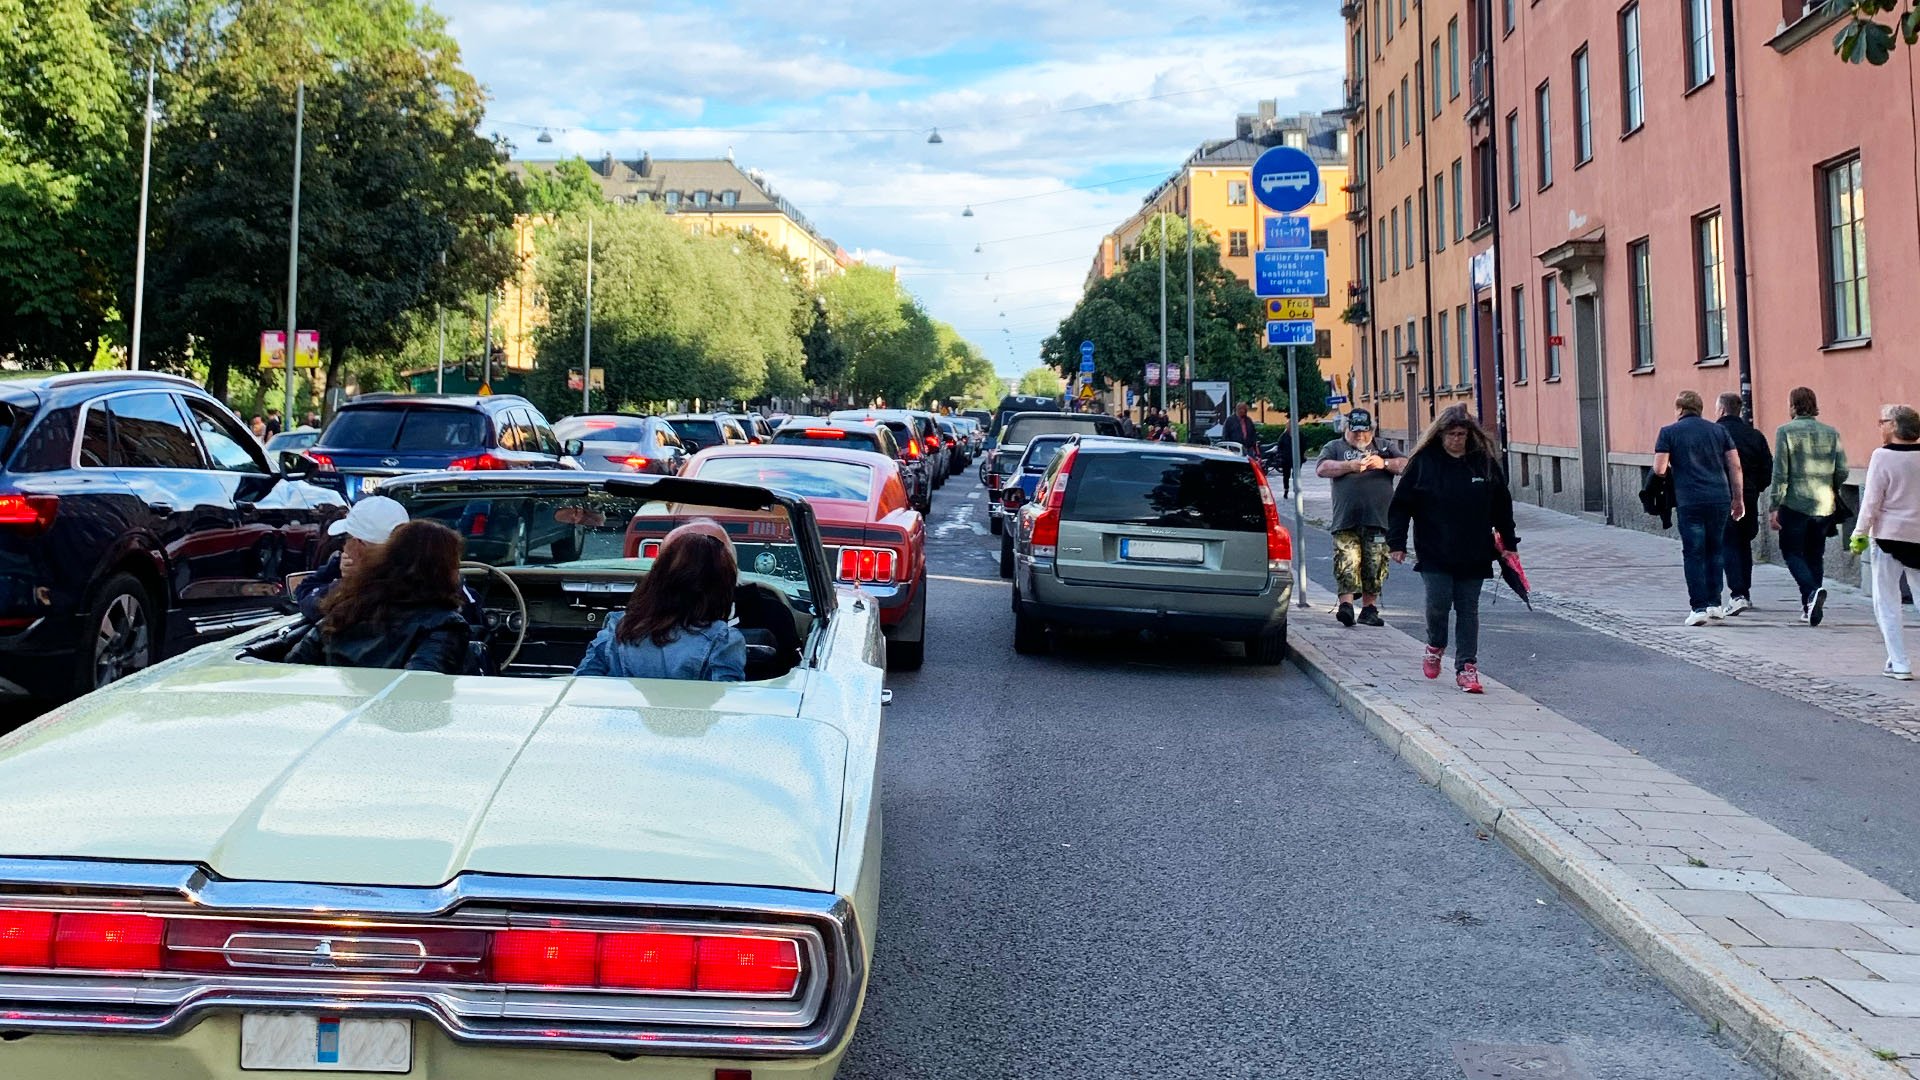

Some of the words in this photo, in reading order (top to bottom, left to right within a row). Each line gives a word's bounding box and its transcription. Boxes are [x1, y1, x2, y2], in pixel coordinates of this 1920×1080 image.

[1288, 309, 1309, 318] 0-6
[1282, 322, 1312, 335] Övrig
[1292, 333, 1307, 343] tid
